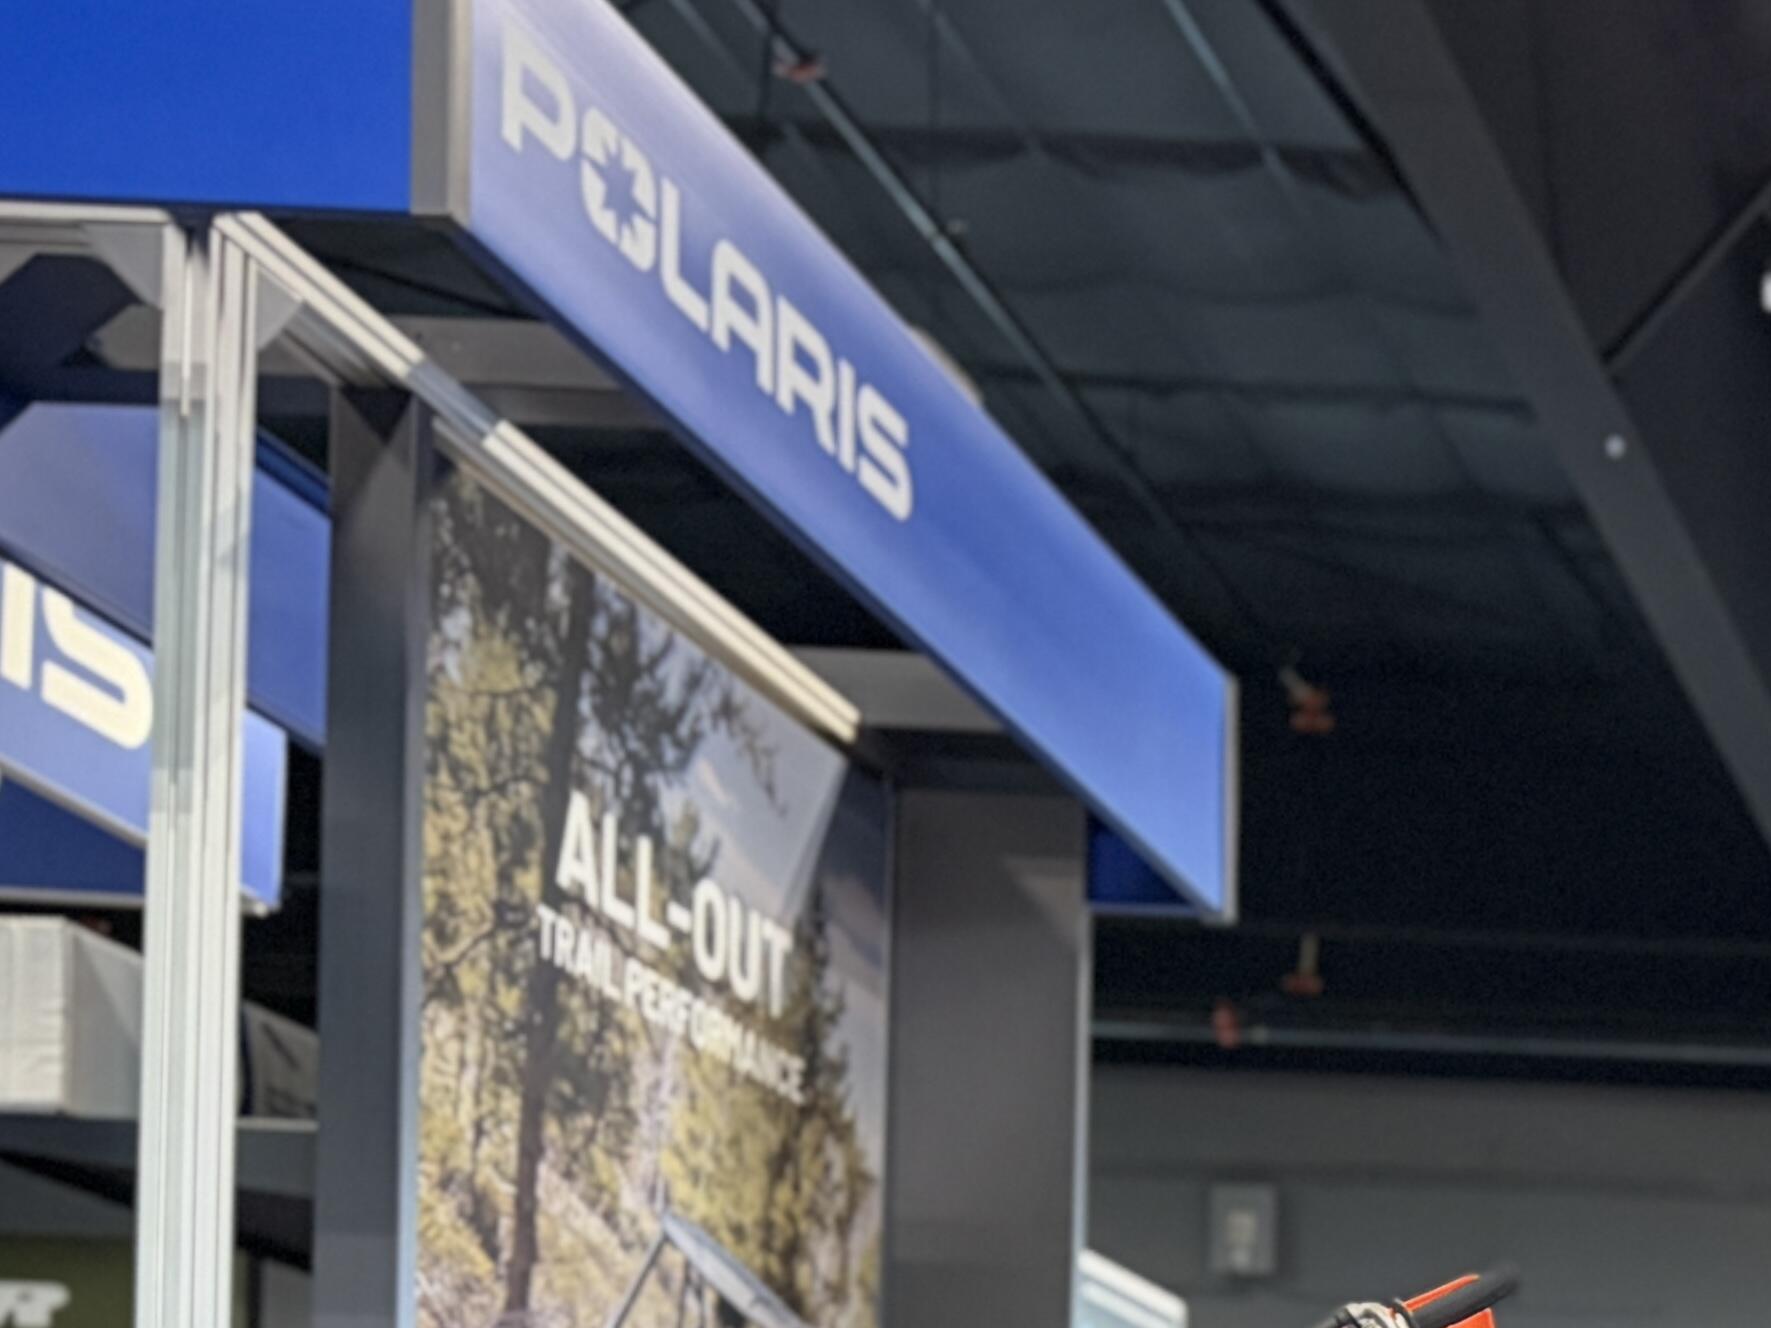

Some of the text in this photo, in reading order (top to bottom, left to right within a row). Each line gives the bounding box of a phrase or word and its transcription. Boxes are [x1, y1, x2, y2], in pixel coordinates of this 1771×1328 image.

[501, 18, 915, 522] POLARIS
[537, 902, 622, 1000] TRAIL
[556, 788, 793, 1018] ALL-OUT
